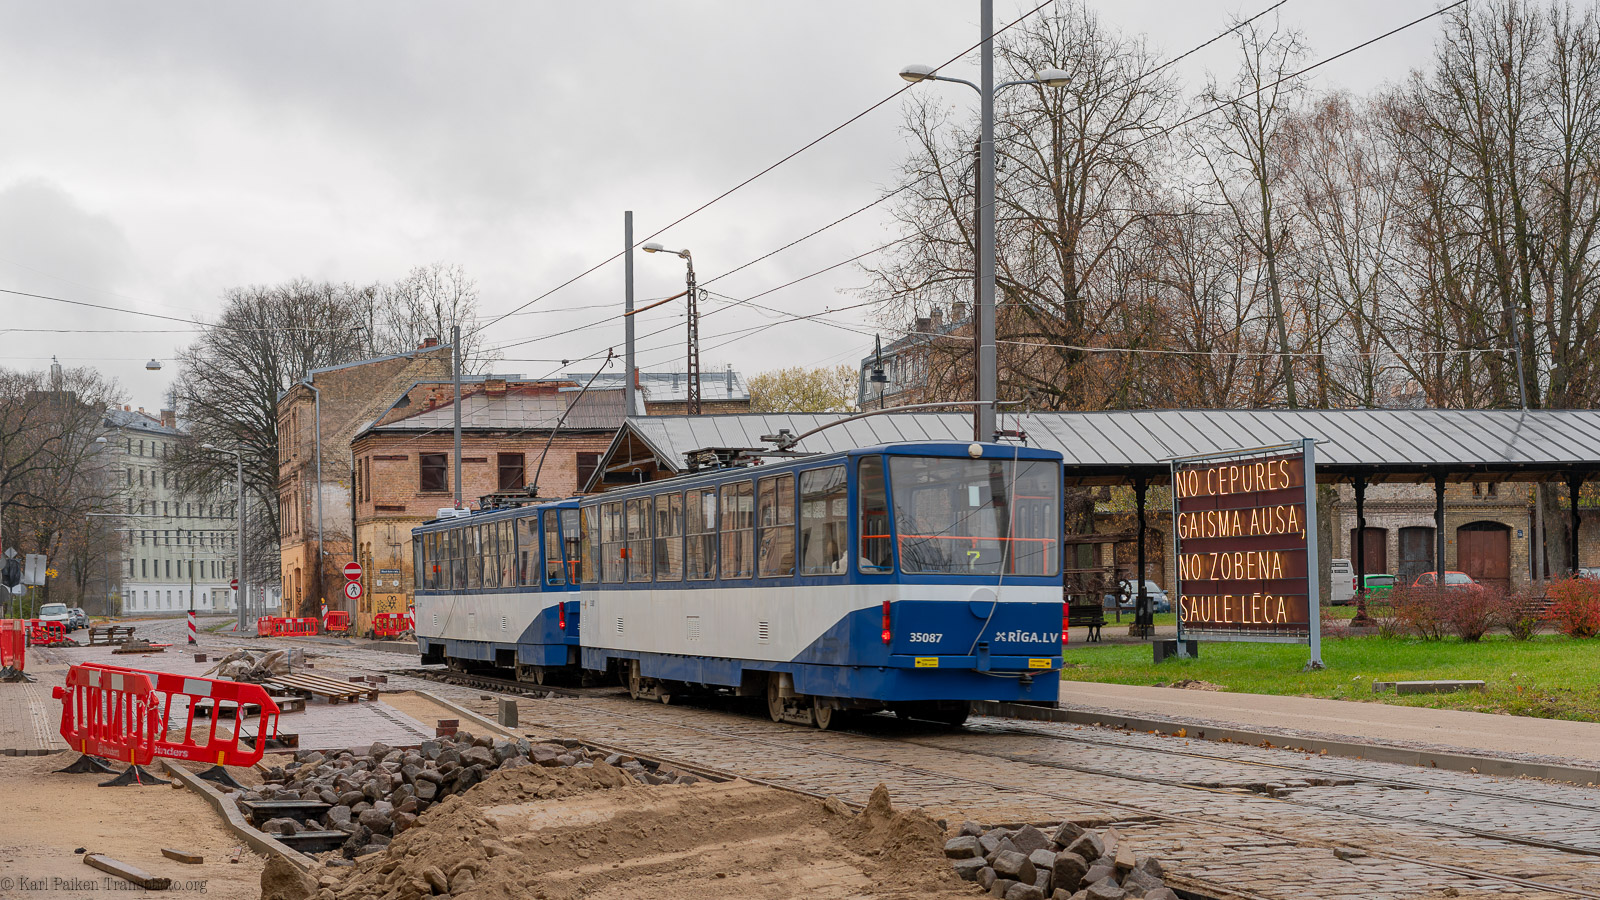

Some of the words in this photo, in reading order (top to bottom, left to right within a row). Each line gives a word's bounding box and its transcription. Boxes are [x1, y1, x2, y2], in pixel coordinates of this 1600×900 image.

[1176, 469, 1199, 498] NO
[1207, 459, 1290, 496] CEPURES
[1178, 510, 1242, 539] GAISMA
[1250, 505, 1306, 540] AUSA,
[966, 550, 981, 570] 7
[1179, 553, 1202, 581] NO
[1210, 551, 1283, 581] ZOBENA
[1180, 595, 1233, 622] SAULE
[1241, 592, 1287, 624] LĒCA
[909, 632, 943, 643] 35087
[1007, 629, 1059, 643] RĪGA.LV
